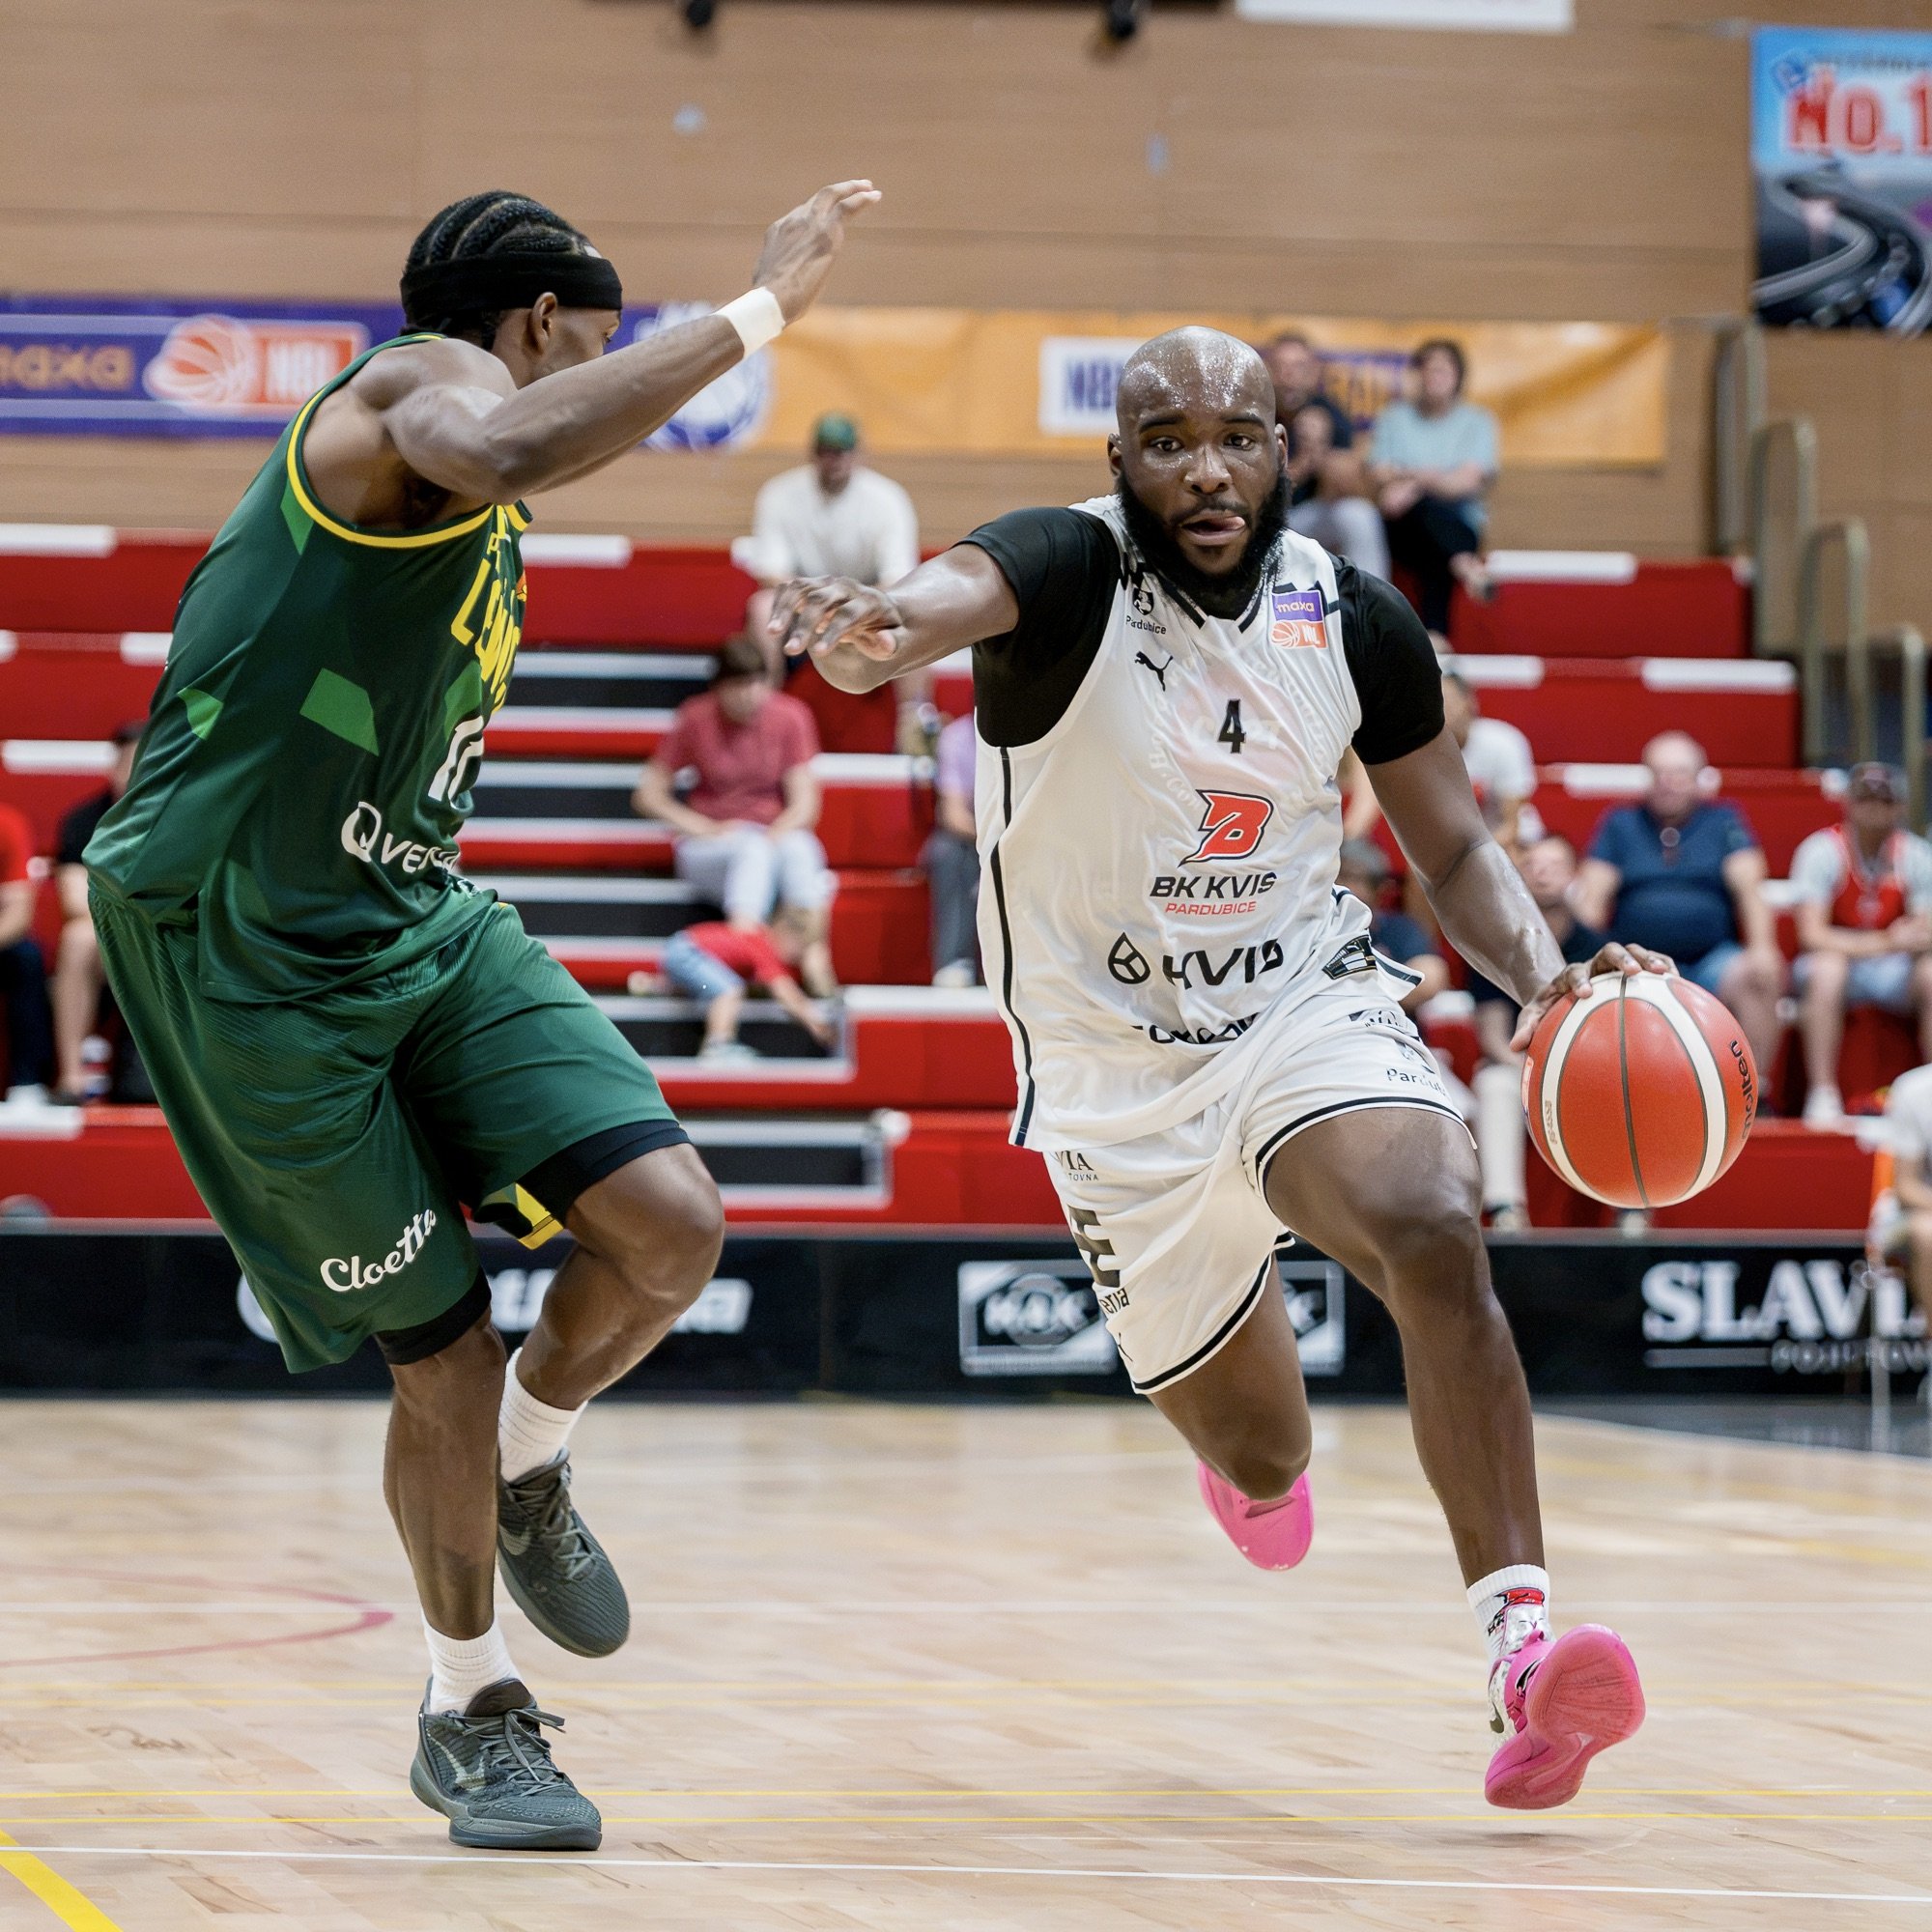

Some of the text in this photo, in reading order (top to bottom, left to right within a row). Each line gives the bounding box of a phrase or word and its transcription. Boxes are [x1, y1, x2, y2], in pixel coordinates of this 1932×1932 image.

[0, 343, 133, 391] axa
[1277, 601, 1315, 613] maxa
[1125, 615, 1167, 635] Padubice
[1217, 698, 1246, 754] 4
[1150, 871, 1277, 899] BK KVIS
[1165, 900, 1257, 916] PARDUBICE
[1642, 1259, 1928, 1342] SLAVI
